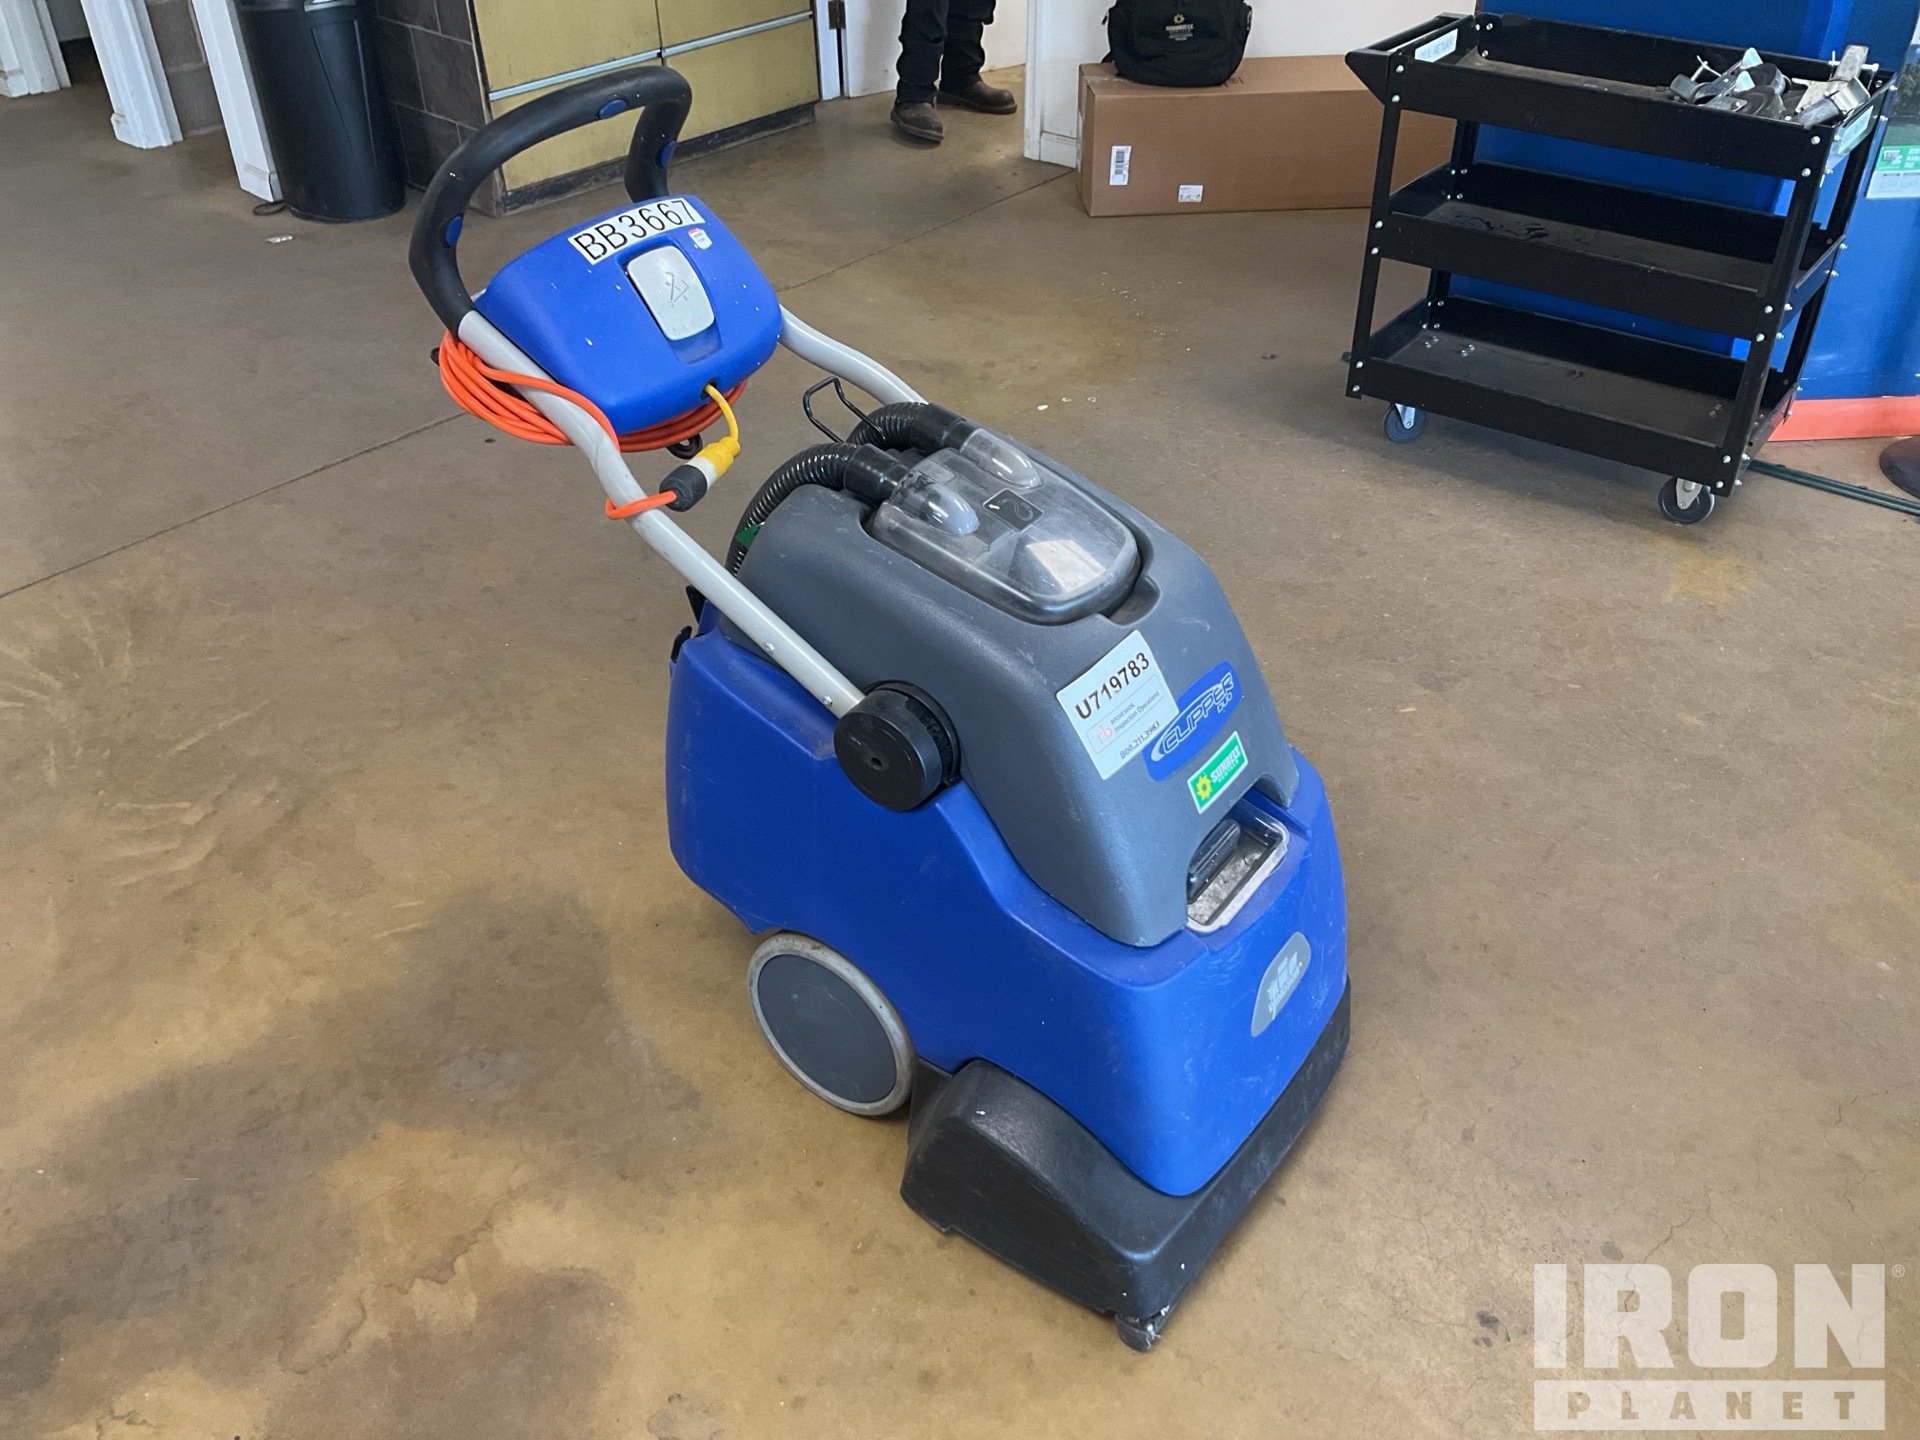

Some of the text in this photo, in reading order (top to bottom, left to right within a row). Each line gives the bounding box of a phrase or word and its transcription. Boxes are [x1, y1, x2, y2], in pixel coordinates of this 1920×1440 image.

[573, 200, 695, 261] BB3667
[1073, 652, 1150, 720] U719783
[1216, 692, 1233, 714] DUO
[1114, 691, 1160, 733] Inspection Operations
[1161, 672, 1235, 755] CLIPPER
[1210, 745, 1242, 784] SUNBELT
